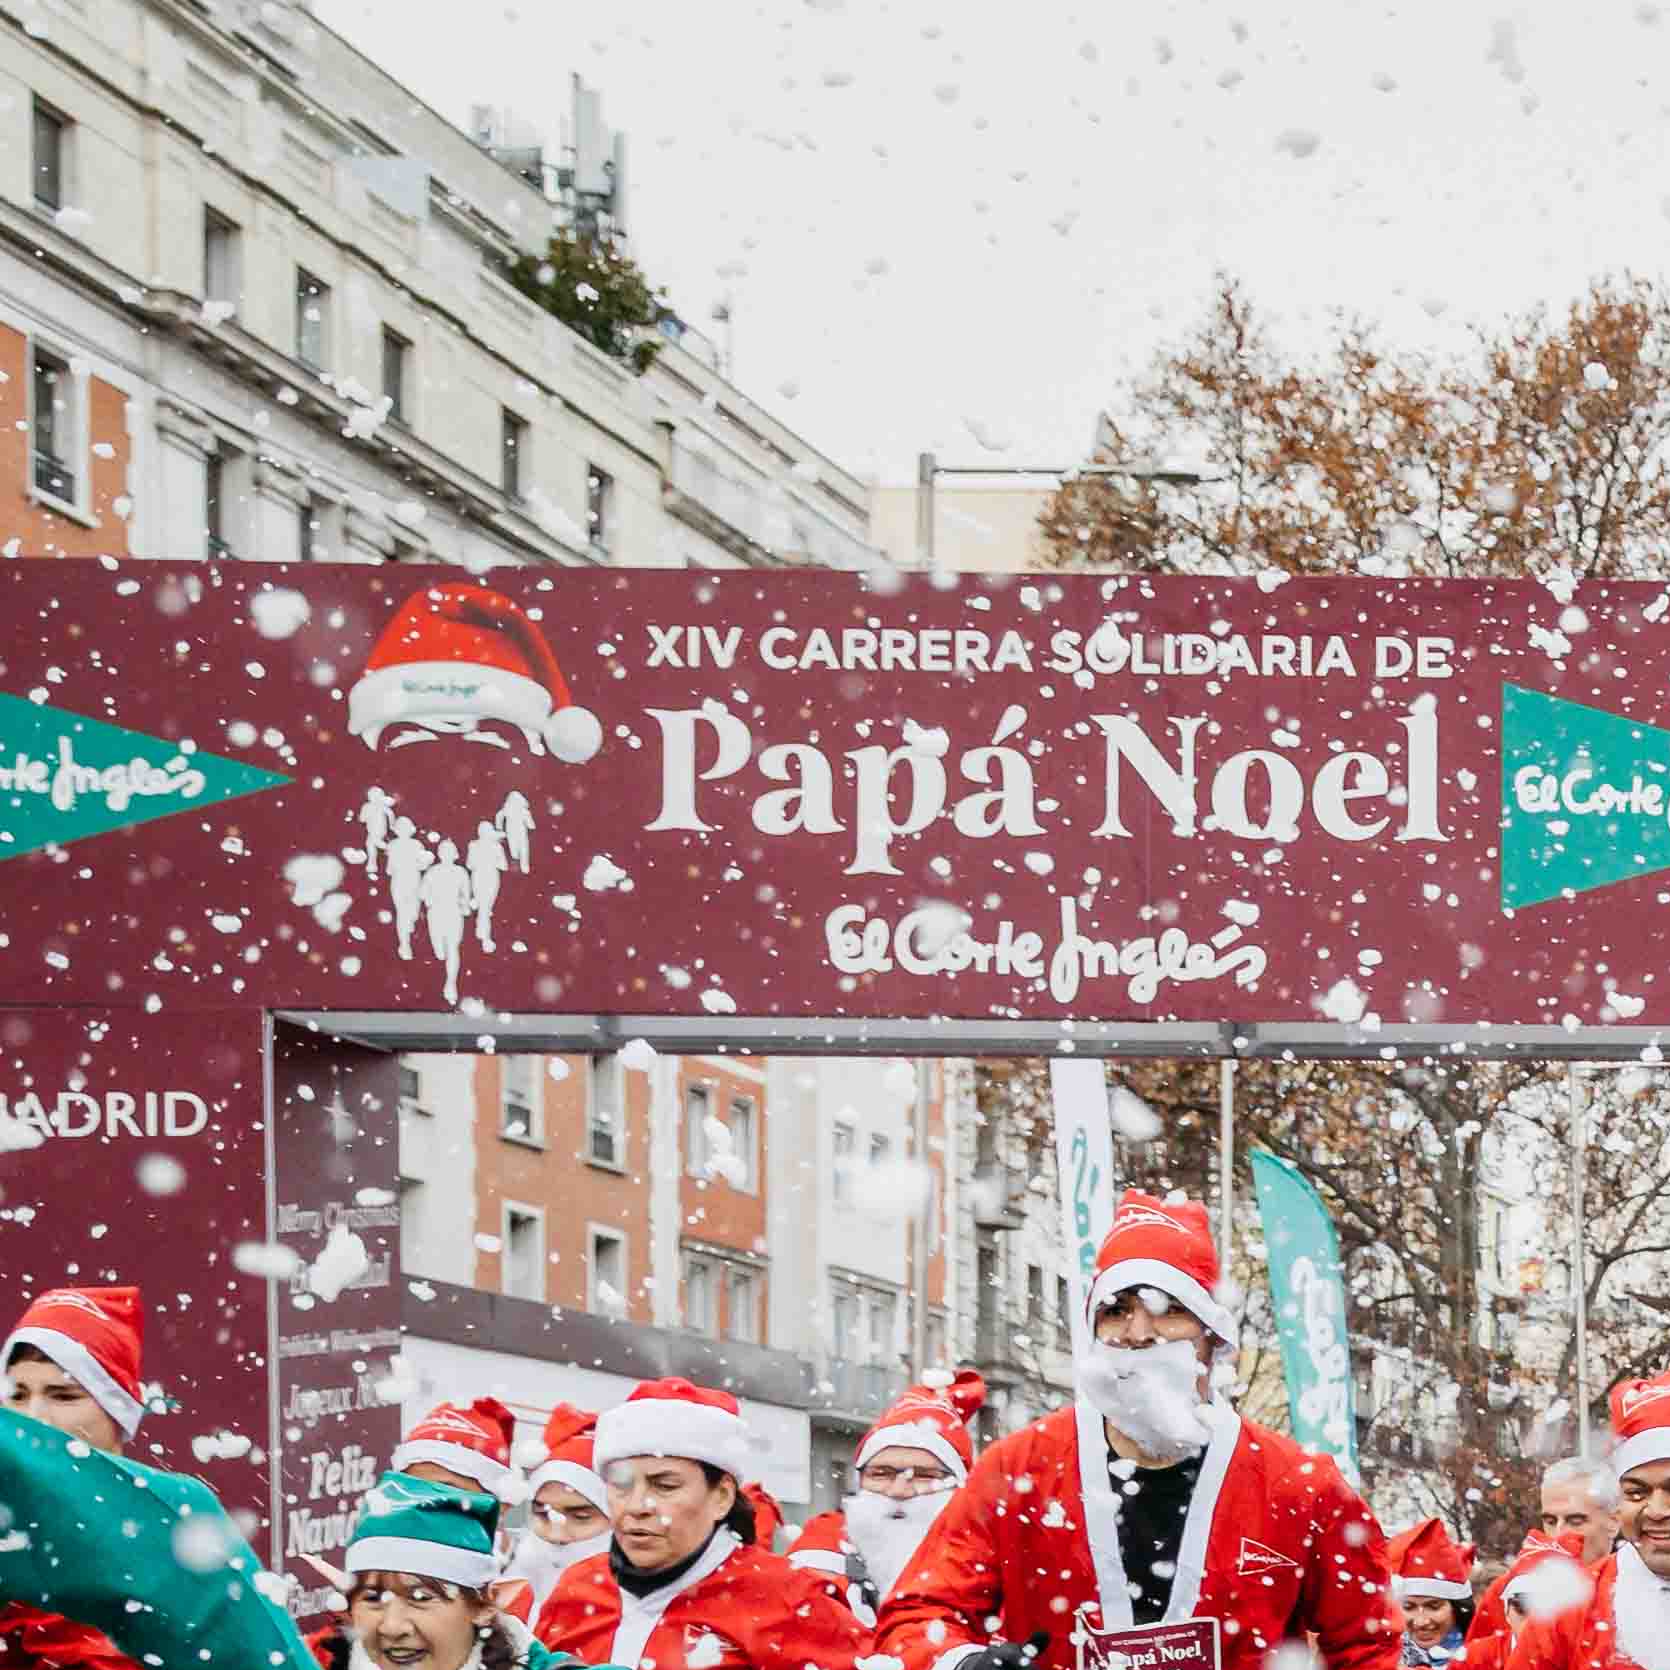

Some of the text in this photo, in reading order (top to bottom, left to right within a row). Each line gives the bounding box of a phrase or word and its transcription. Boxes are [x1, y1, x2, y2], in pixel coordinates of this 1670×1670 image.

[648, 627, 1453, 677] XIV CARRERA SOLIDARIA DE
[52, 735, 206, 811] Inglés
[646, 704, 1449, 874] Papá Noel
[1515, 765, 1559, 812] El
[1562, 769, 1663, 815] Corte
[826, 896, 1266, 1003] El Corte Inglés
[0, 1091, 209, 1137] ADRID
[309, 1445, 376, 1499] Feliz
[1159, 1640, 1202, 1663] Noel
